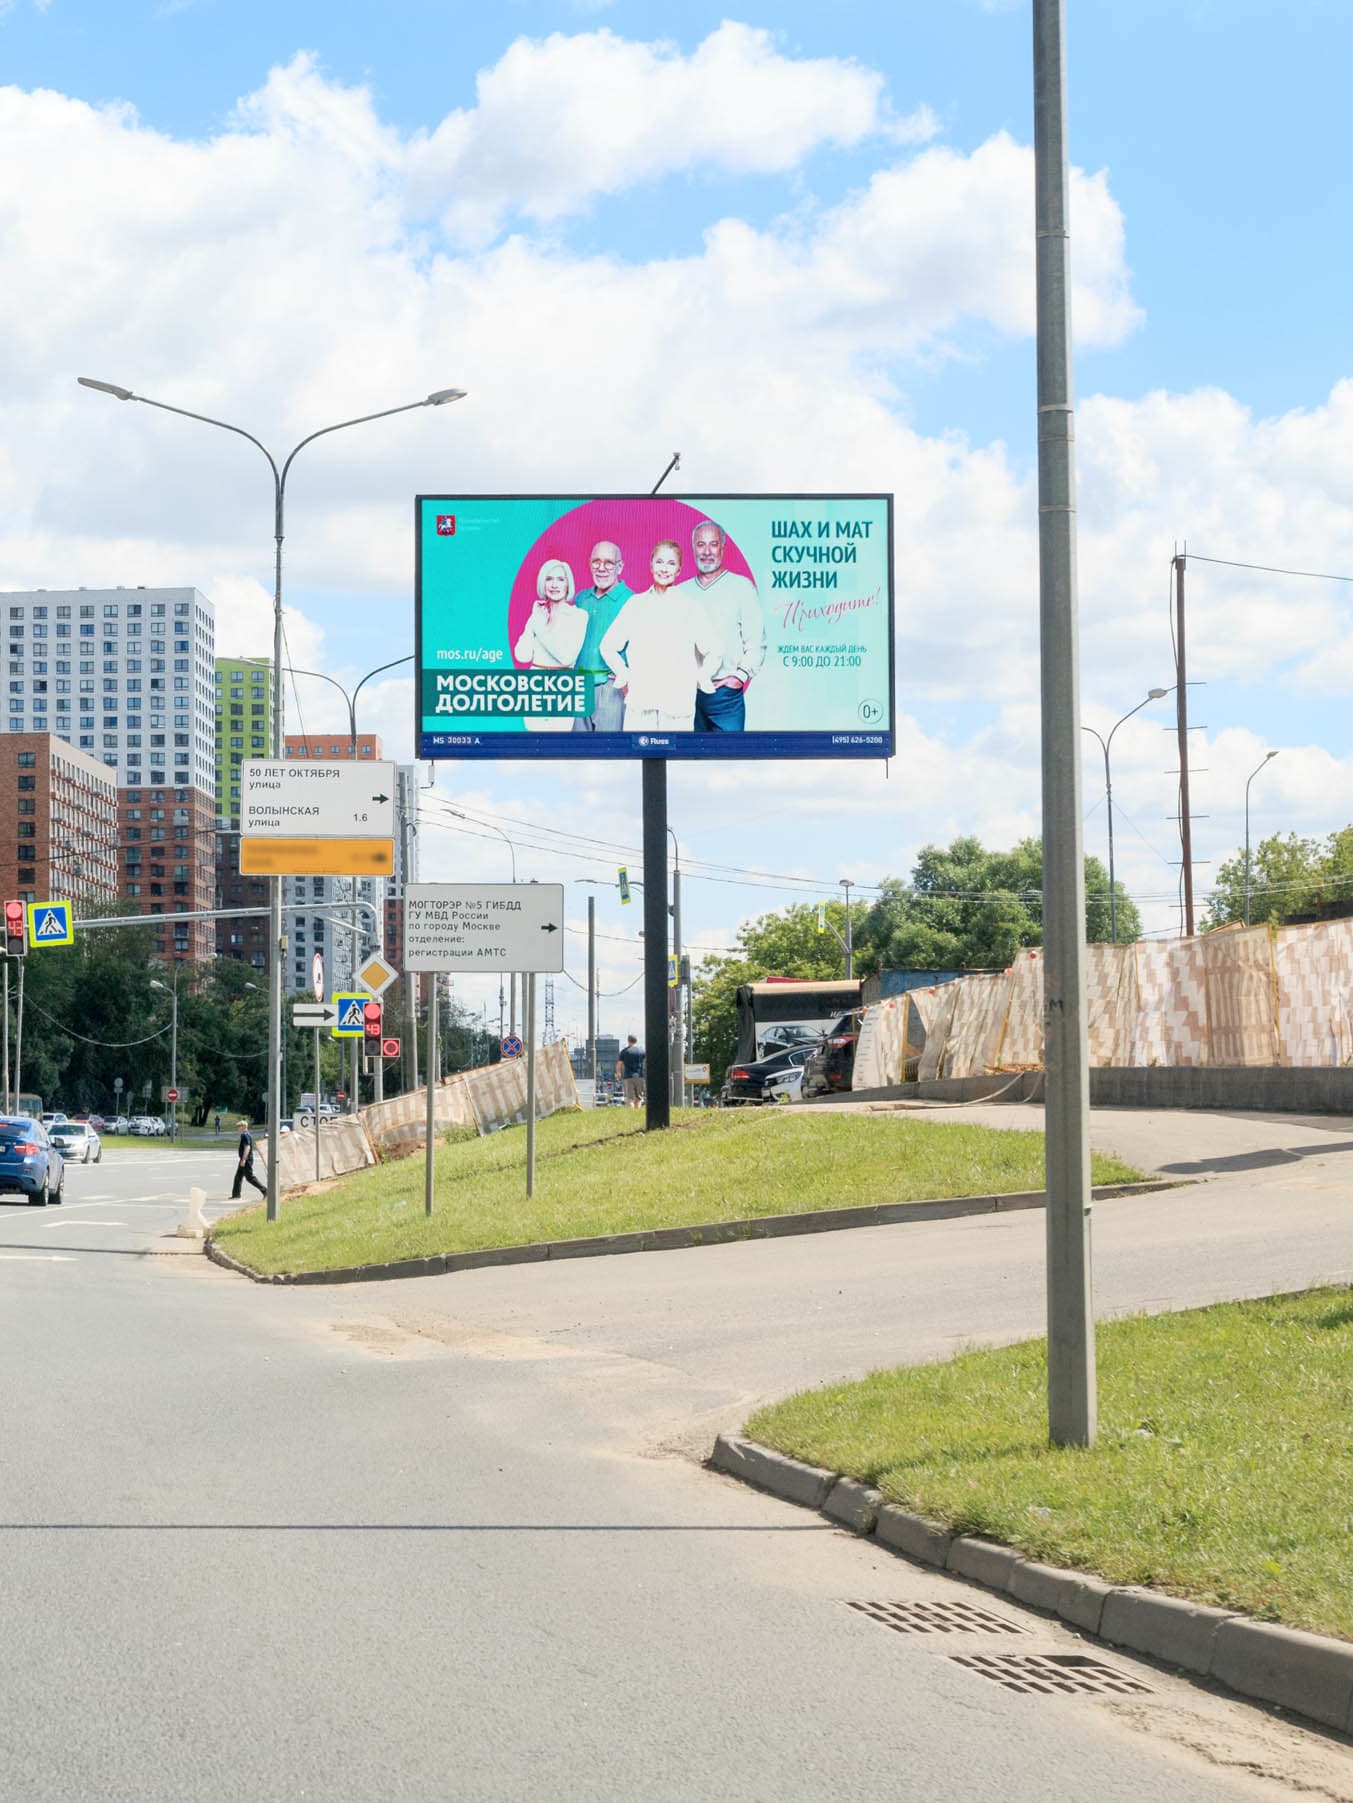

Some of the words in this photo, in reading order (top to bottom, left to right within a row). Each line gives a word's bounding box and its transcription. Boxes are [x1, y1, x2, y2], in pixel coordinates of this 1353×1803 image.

[771, 520, 813, 538] ШАХ
[817, 520, 830, 538] И
[835, 520, 873, 538] МАТ
[771, 542, 857, 564] СКУЧНОЙ
[771, 570, 838, 589] ЖИЗНИ
[800, 645, 813, 654] ВАС
[815, 643, 847, 654] КАЖДЫЙ
[436, 647, 504, 663] mos.ru/age
[783, 655, 790, 667] С
[791, 655, 814, 667] 9:00
[815, 655, 831, 668] ДО
[833, 655, 862, 667] 21:00
[436, 674, 586, 692] МОСКОВСКОЕ
[435, 694, 586, 714] ДОЛГОЛЕТИЕ
[863, 704, 879, 719] 0+
[249, 768, 262, 777] 50
[264, 768, 286, 777] ЛЕТ
[288, 768, 340, 778] ОКТЯБРЯ
[249, 781, 281, 790] улица
[248, 806, 320, 816] ВОЛЫНСКАЯ
[353, 813, 368, 822] 1.6
[248, 819, 280, 828] улица
[408, 900, 462, 909] МОГТОРЭР
[486, 901, 522, 910] ГИБДД
[408, 911, 422, 920] ГУ
[425, 911, 449, 921] МВД
[452, 911, 489, 920] России
[423, 923, 459, 932] городу
[462, 922, 501, 930] Москве
[408, 949, 473, 957] регистрации
[476, 948, 507, 957] АМТС
